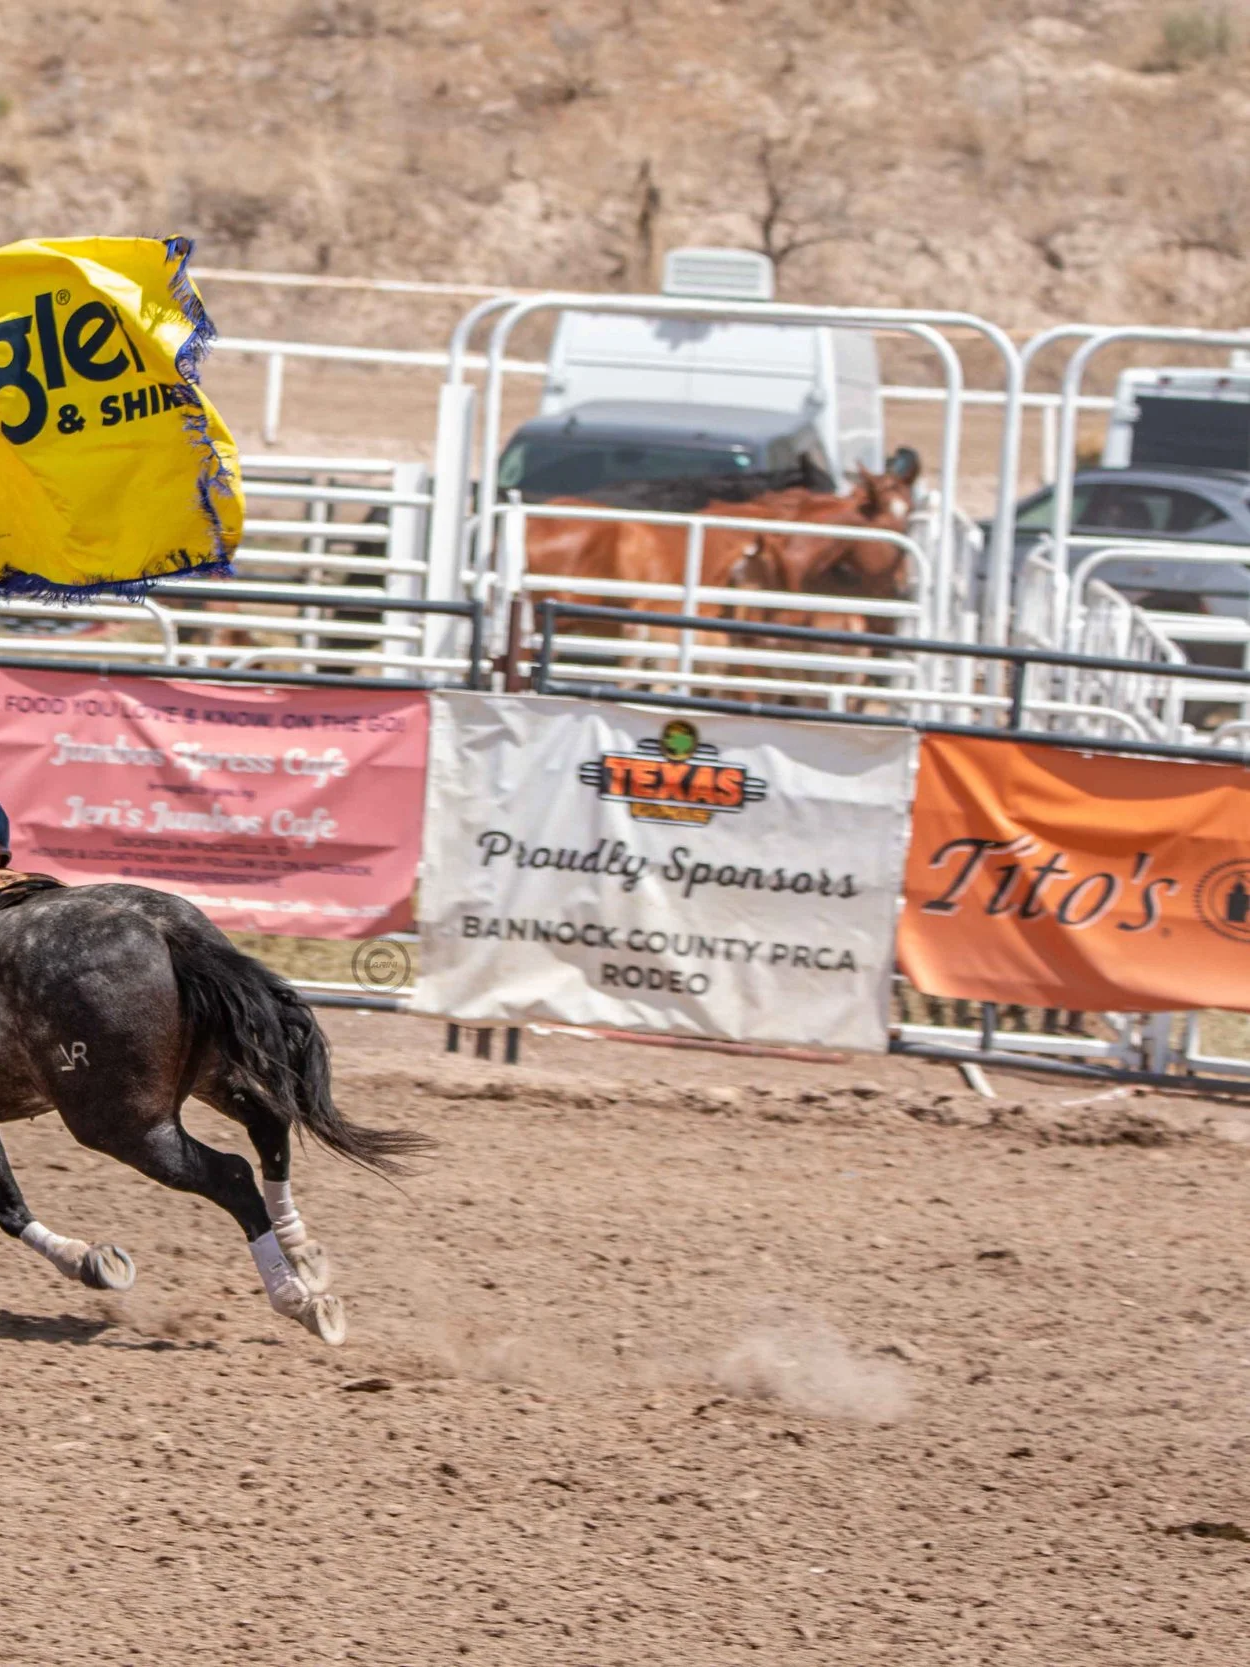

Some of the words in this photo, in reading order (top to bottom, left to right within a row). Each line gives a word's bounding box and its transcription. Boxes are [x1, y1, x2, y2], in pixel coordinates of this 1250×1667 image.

[57, 404, 86, 434] &
[100, 383, 184, 427] SHIR
[5, 695, 67, 715] FOOD
[74, 699, 117, 718] YOU
[320, 714, 362, 733] THE
[603, 757, 745, 807] TEXAS
[146, 801, 264, 835] Jumbos
[271, 808, 339, 849] Cafe
[476, 830, 649, 892] Proudly
[662, 846, 858, 899] Sponsors
[920, 836, 1180, 932] Tito's
[462, 915, 621, 951] BANNOCK
[626, 929, 761, 963] COUNTY
[766, 942, 858, 973] PRCA
[600, 962, 711, 996] RODEO
